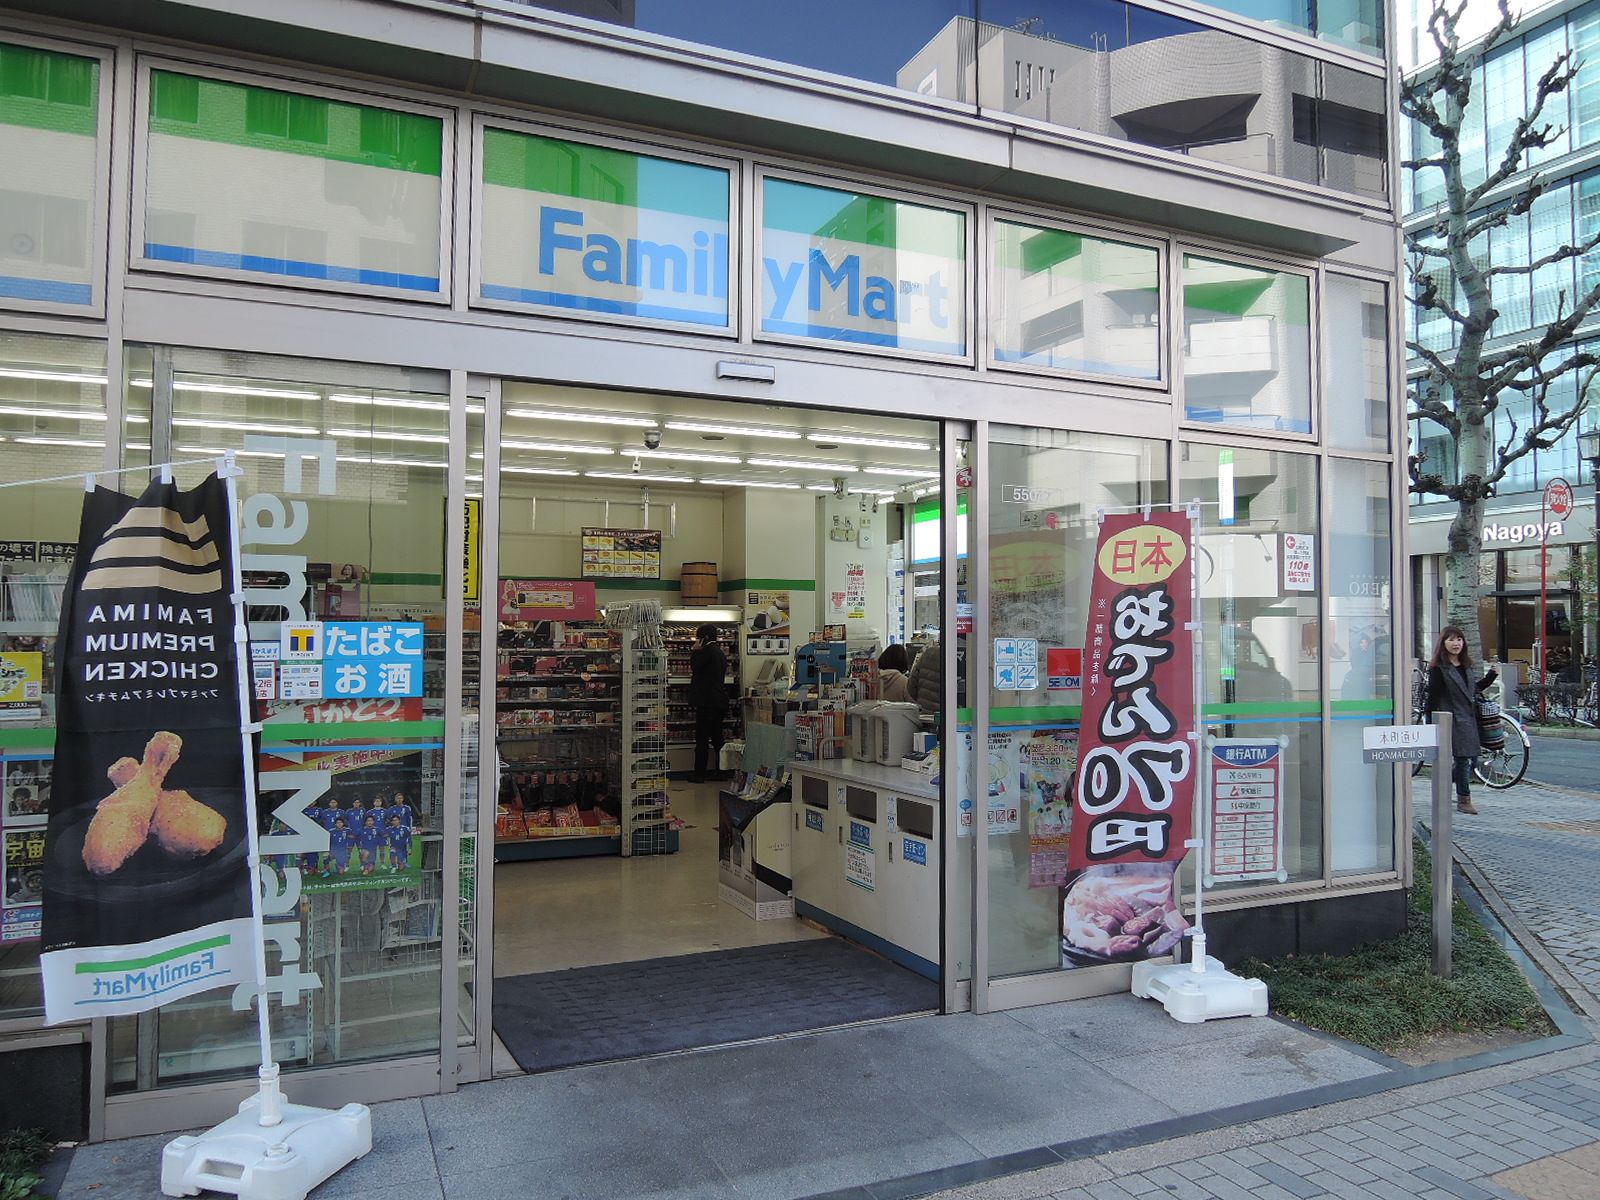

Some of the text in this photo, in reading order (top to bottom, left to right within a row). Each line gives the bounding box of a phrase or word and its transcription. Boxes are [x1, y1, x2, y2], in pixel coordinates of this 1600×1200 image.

[538, 205, 950, 330] FamilyMart
[1483, 520, 1564, 543] Nagoya
[326, 625, 422, 656] たばこ
[334, 662, 412, 695] お酒
[1048, 677, 1080, 688] SECOM
[1379, 731, 1421, 745] 本町通り
[1225, 747, 1267, 761] 銀行ATM
[1371, 750, 1416, 760] HONMACHI
